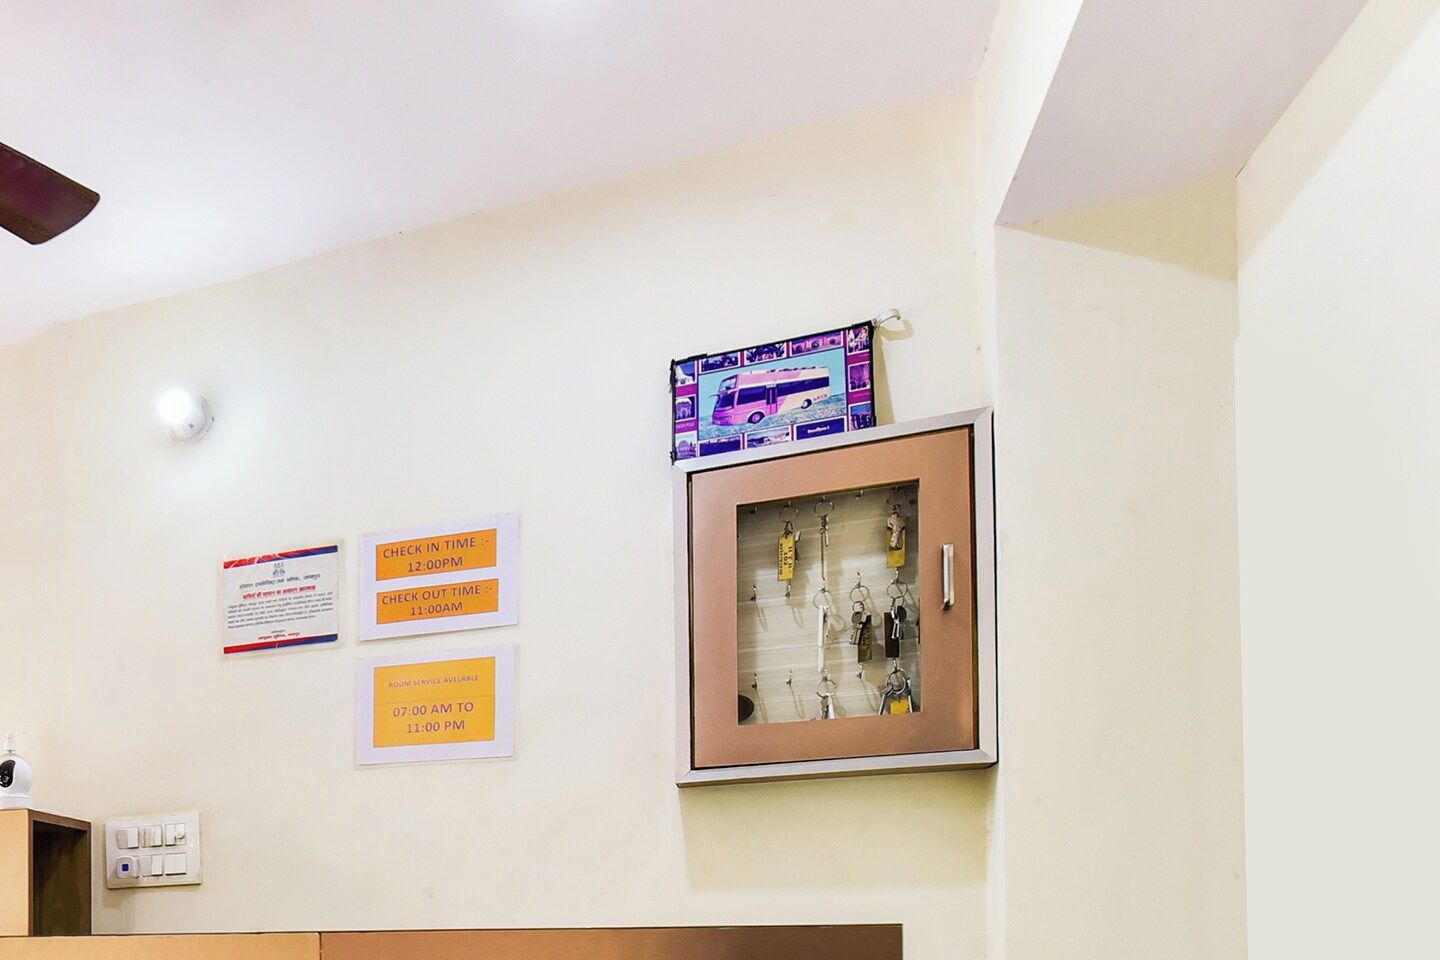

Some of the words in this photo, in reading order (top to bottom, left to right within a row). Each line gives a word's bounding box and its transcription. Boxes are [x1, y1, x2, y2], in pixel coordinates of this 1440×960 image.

[383, 545, 423, 559] CHECK
[427, 542, 440, 552] IN
[444, 537, 477, 550] TIME
[408, 556, 463, 573] 12:00PM
[382, 591, 419, 605] CHECK
[422, 588, 447, 600] OUT
[451, 584, 481, 597] TIME
[410, 601, 463, 616] 11:00AM
[388, 680, 411, 689] ROOM
[412, 677, 442, 687] SERVICE
[393, 705, 427, 717] 07:00
[430, 703, 453, 715] AM
[456, 701, 474, 713] TO
[406, 721, 440, 734] 11:00
[444, 720, 465, 731] PM
